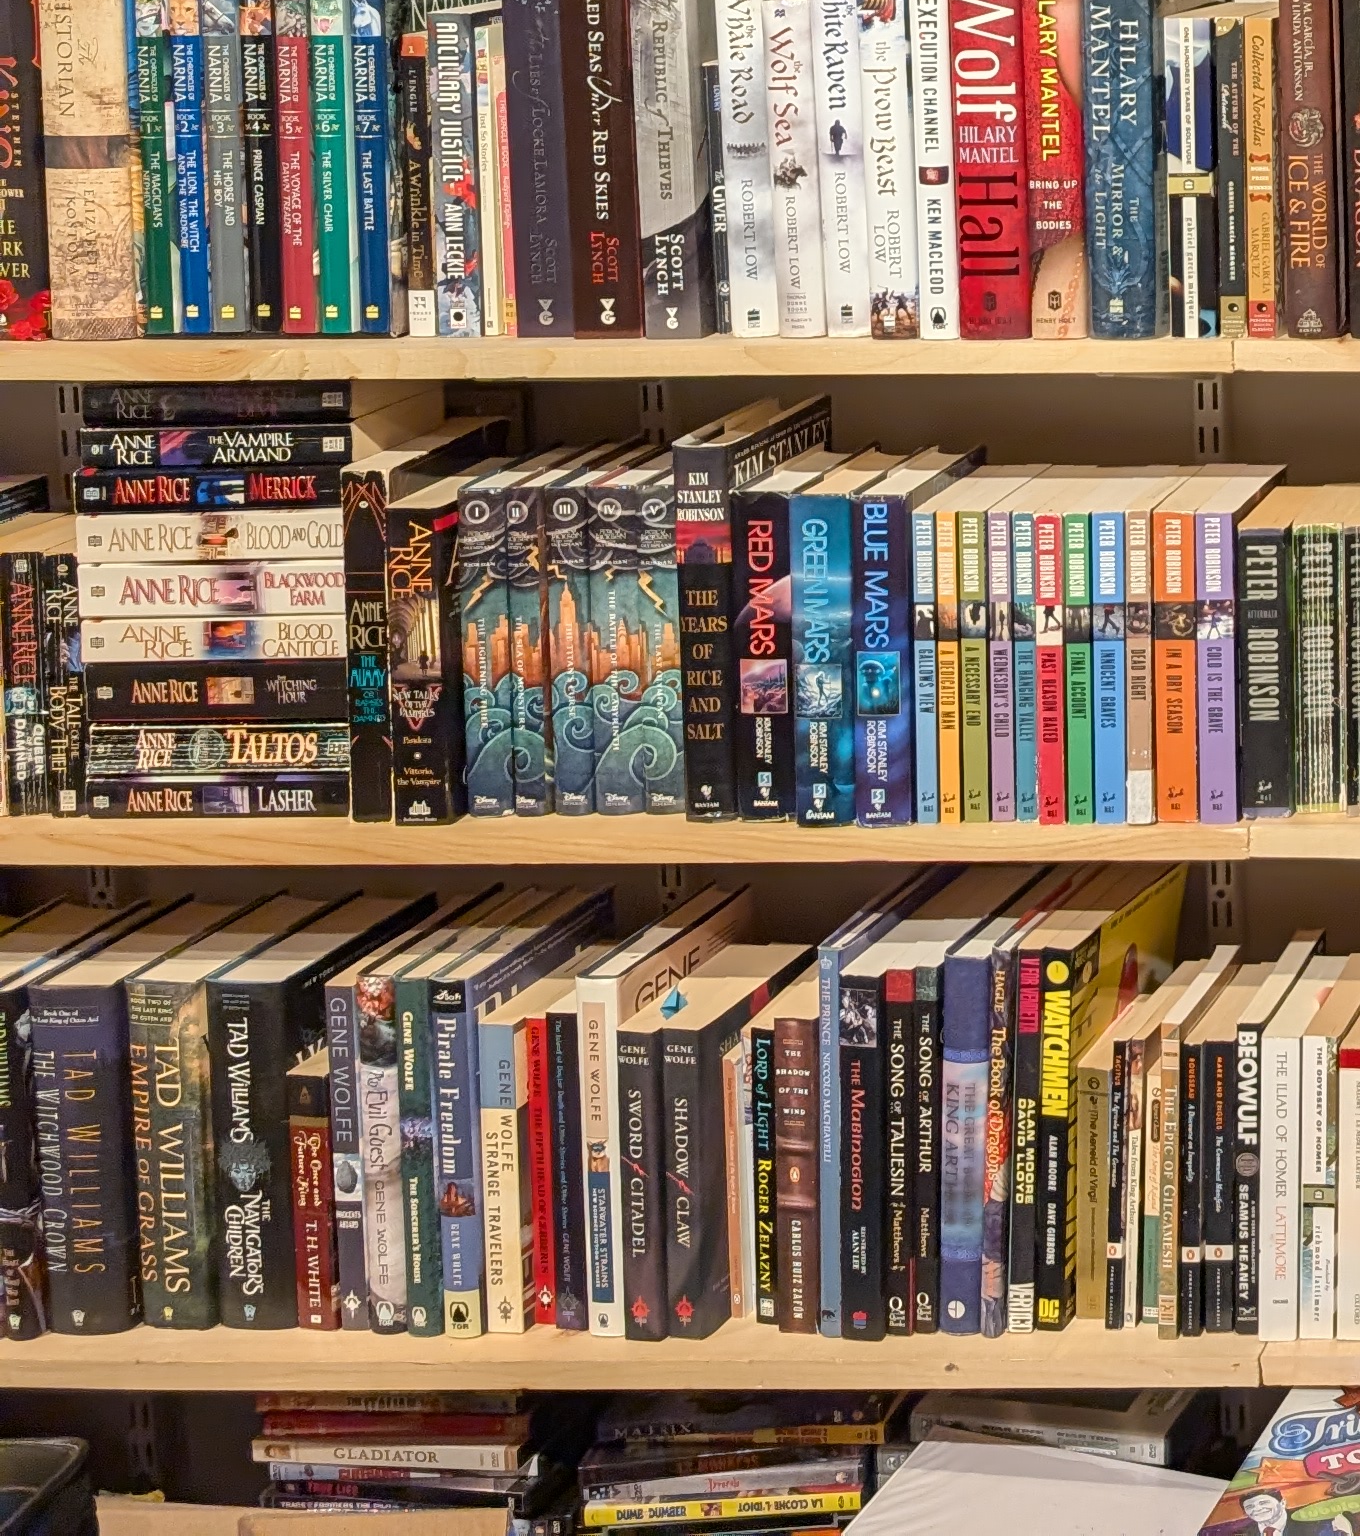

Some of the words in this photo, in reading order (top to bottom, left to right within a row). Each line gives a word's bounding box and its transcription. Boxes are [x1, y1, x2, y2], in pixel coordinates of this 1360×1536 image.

[436, 22, 459, 111] ANCILLARY
[922, 84, 940, 154] CHANNEL
[441, 114, 463, 181] JUSTICE
[958, 126, 1018, 144] HILARY
[959, 146, 1019, 163] MANTEL
[1030, 180, 1059, 189] BRING
[1063, 180, 1078, 188] UP
[1043, 201, 1062, 209] THE
[958, 171, 1020, 280] Hall
[1036, 221, 1072, 229] BODIES
[110, 433, 155, 450] ANNE
[208, 435, 224, 444] THE
[224, 432, 294, 448] VAMPIRE
[117, 450, 152, 464] RICE
[212, 447, 291, 462] ARMAND
[251, 475, 317, 500] MERRICK
[863, 503, 887, 562] BLUE
[686, 589, 718, 606] THE
[864, 570, 889, 649] MARS
[680, 615, 727, 633] YEARS
[693, 643, 713, 660] OF
[686, 670, 722, 686] RICE
[688, 697, 721, 713] AND
[686, 723, 724, 739] SALT
[227, 731, 318, 763] TALTOS
[258, 788, 316, 812] LASHER
[329, 997, 348, 1058] GENE
[437, 1017, 458, 1079] Pirate
[1041, 990, 1072, 1117] WATCHMEN
[154, 1043, 182, 1109] TAD
[1237, 1031, 1259, 1146] BEOWULF
[131, 1042, 150, 1150] EMPIRE
[332, 1065, 353, 1142] WOLFE
[440, 1087, 459, 1175] Freedom
[139, 1158, 147, 1177] OF
[757, 1159, 773, 1215] ROGER
[157, 1123, 190, 1295] WILLIAMS
[136, 1189, 157, 1282] GRASS
[758, 1221, 773, 1293] ZELAZNY
[333, 1447, 439, 1464] GLADIATOR
